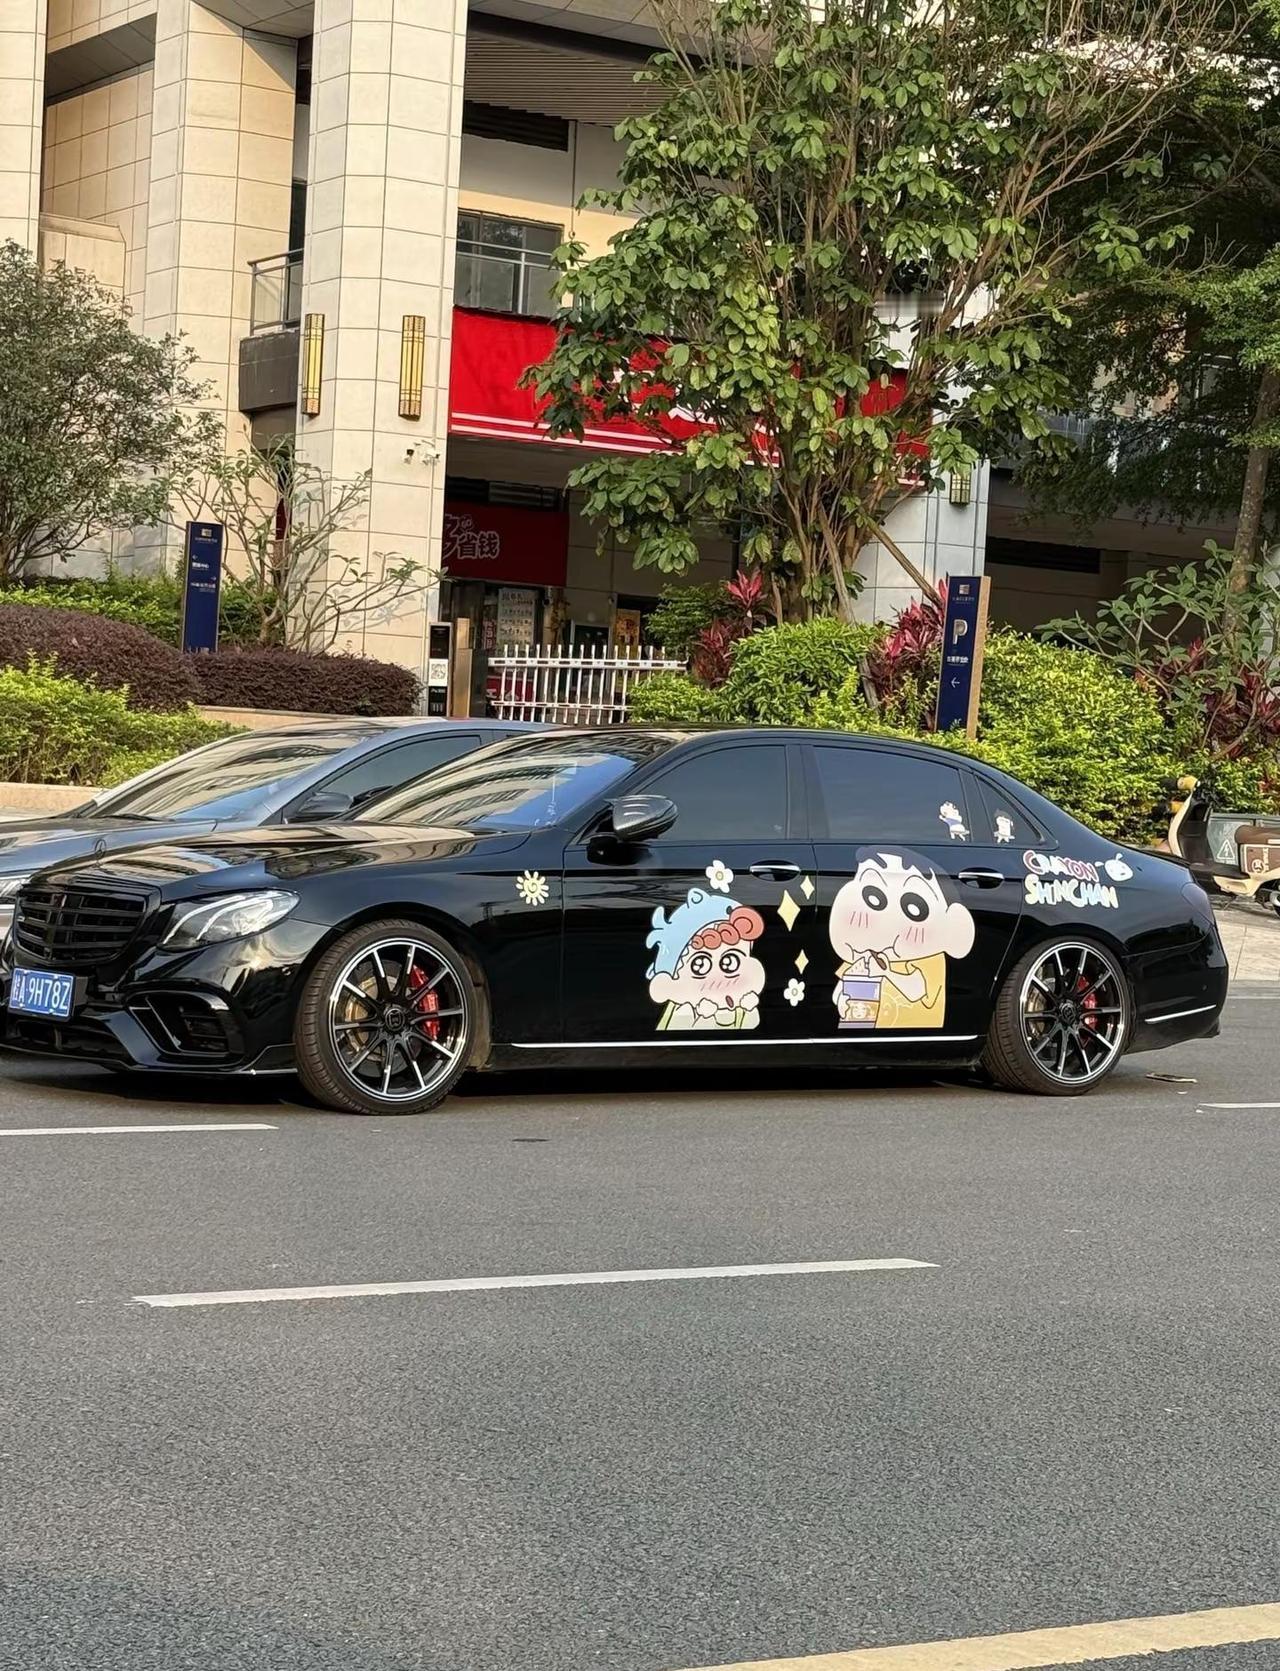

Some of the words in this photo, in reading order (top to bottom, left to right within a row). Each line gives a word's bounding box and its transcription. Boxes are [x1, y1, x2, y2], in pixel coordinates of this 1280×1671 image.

[952, 619, 968, 645] P
[1023, 850, 1099, 882] CRAYON
[1025, 874, 1118, 908] SHINCHAN
